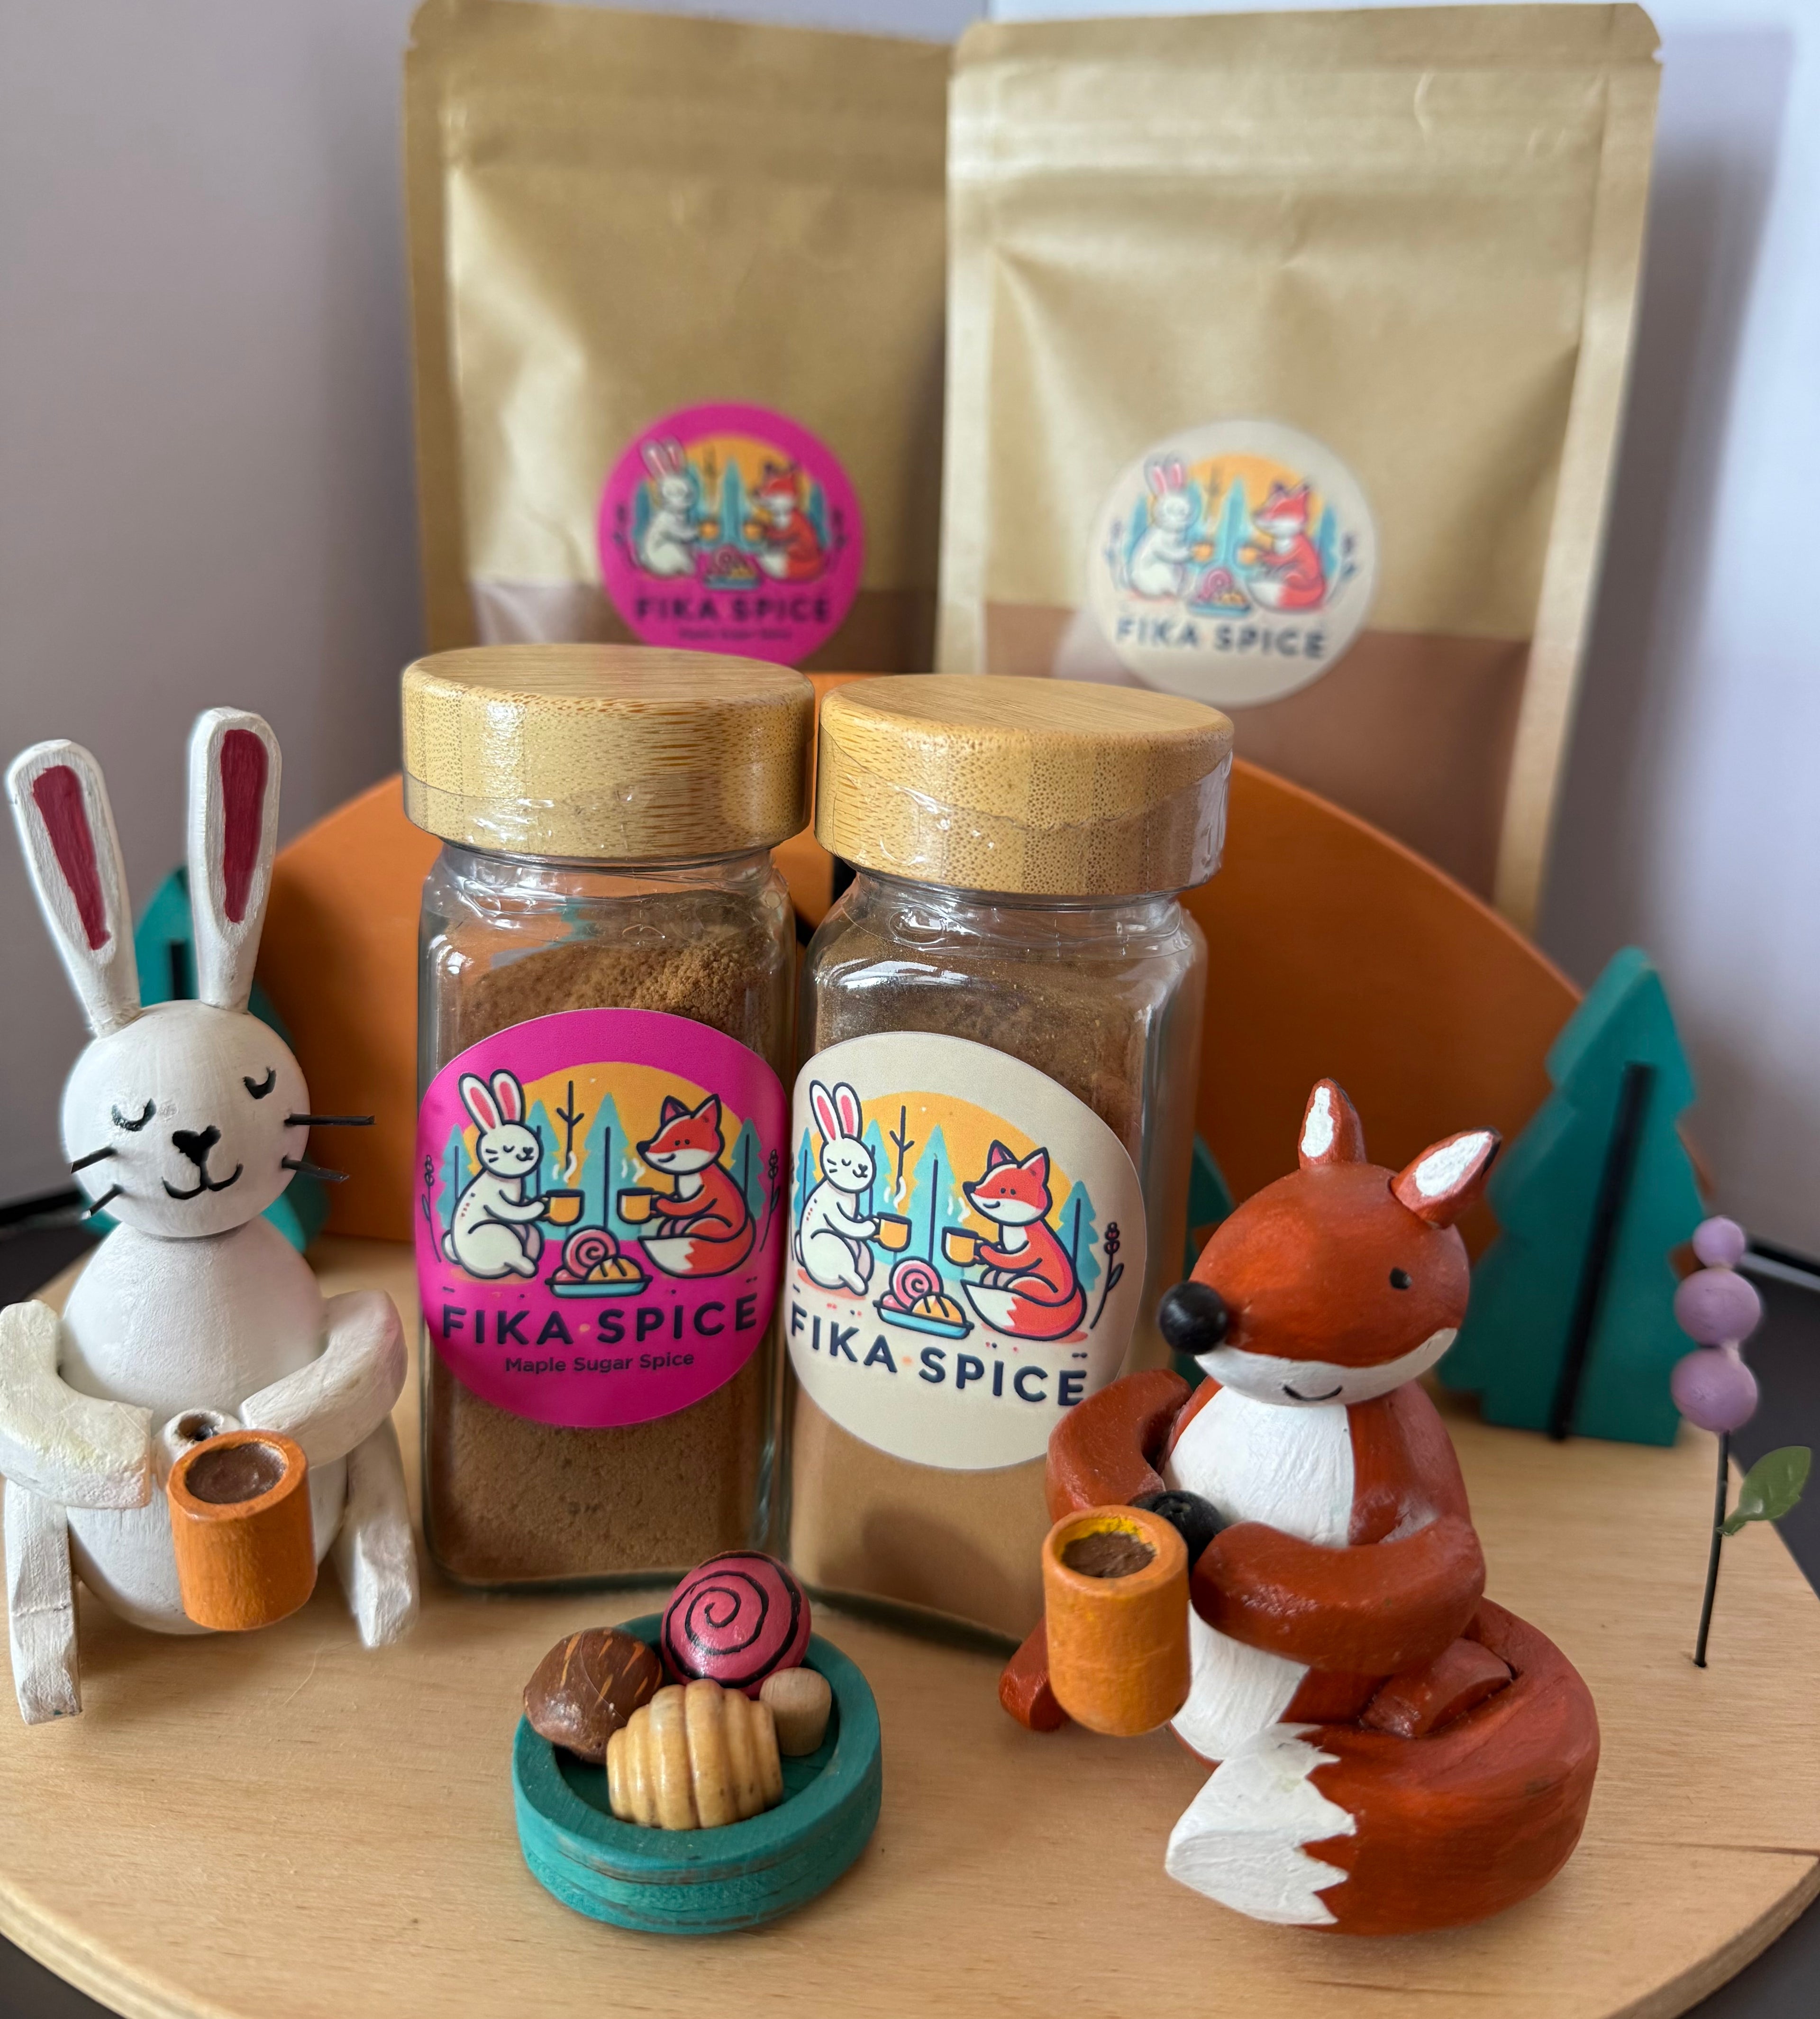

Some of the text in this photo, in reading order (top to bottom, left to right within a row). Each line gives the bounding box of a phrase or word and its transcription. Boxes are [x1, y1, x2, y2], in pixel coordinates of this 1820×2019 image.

[636, 598, 830, 622] FIKA SPICE
[1116, 616, 1326, 658] FIKA SPICE
[443, 1292, 758, 1345] FIKA SPICE
[505, 1352, 695, 1374] Maple Sugar Spice
[792, 1301, 1088, 1406] FIKA SPICE
